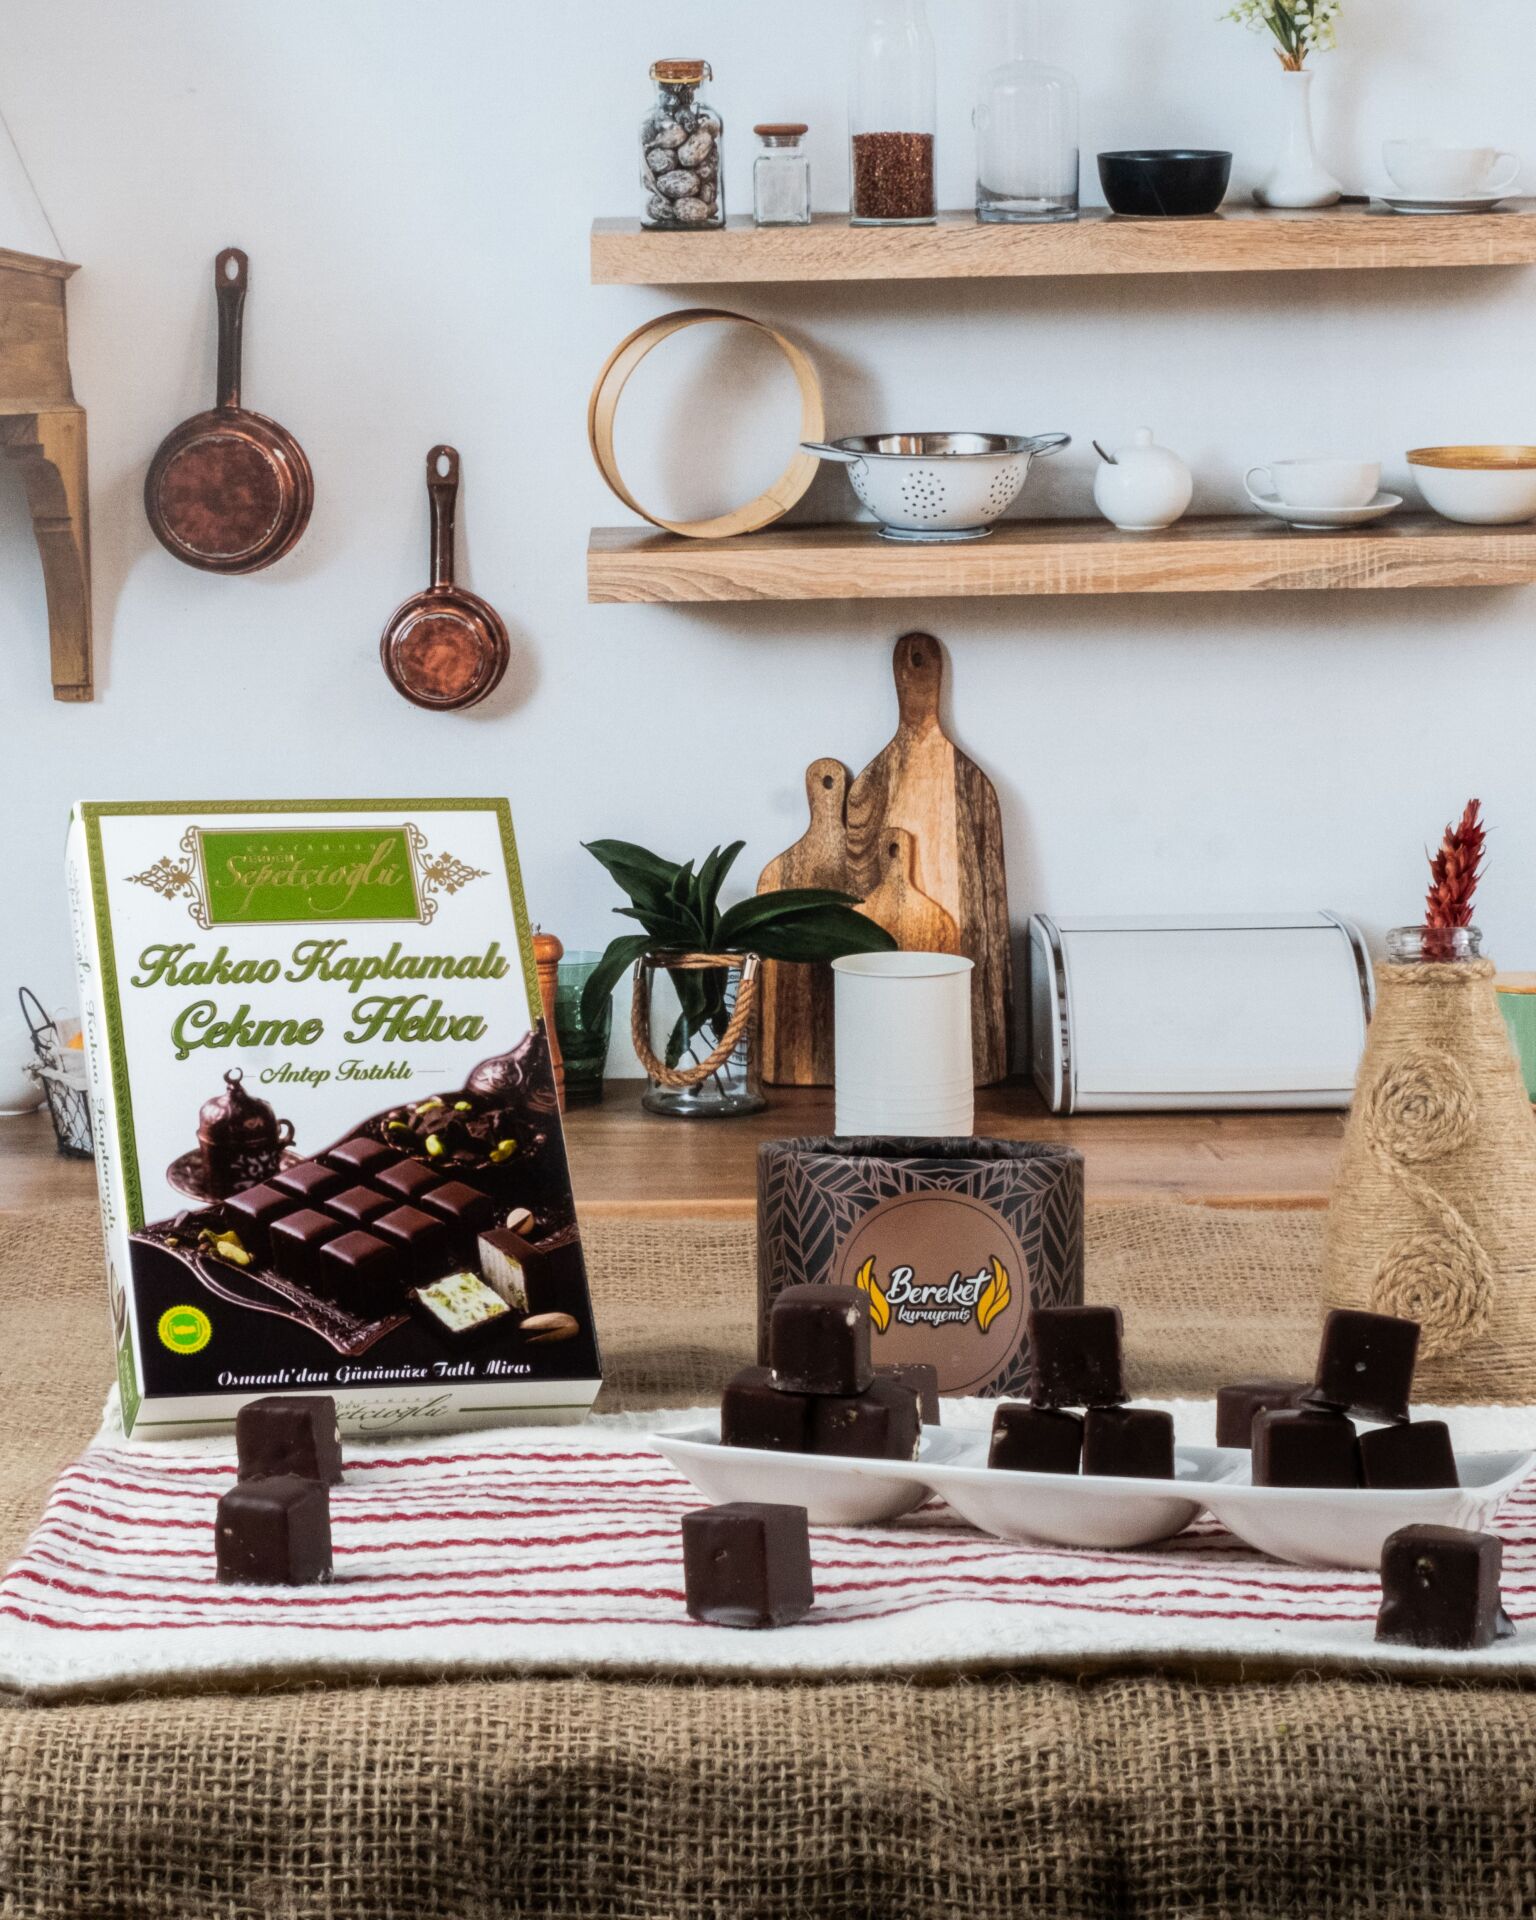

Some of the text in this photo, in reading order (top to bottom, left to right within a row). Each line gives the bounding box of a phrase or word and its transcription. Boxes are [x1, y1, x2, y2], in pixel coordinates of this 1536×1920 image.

[130, 938, 510, 993] Kakao Kaplamalı
[170, 994, 488, 1061] Çekme Helva
[259, 1059, 413, 1088] Antep Fıstıklı
[885, 1266, 992, 1306] Bereket
[898, 1304, 972, 1327] kuruyemiş
[217, 1359, 531, 1386] Osmanlı'dan Günümüze Tatlı Miras
